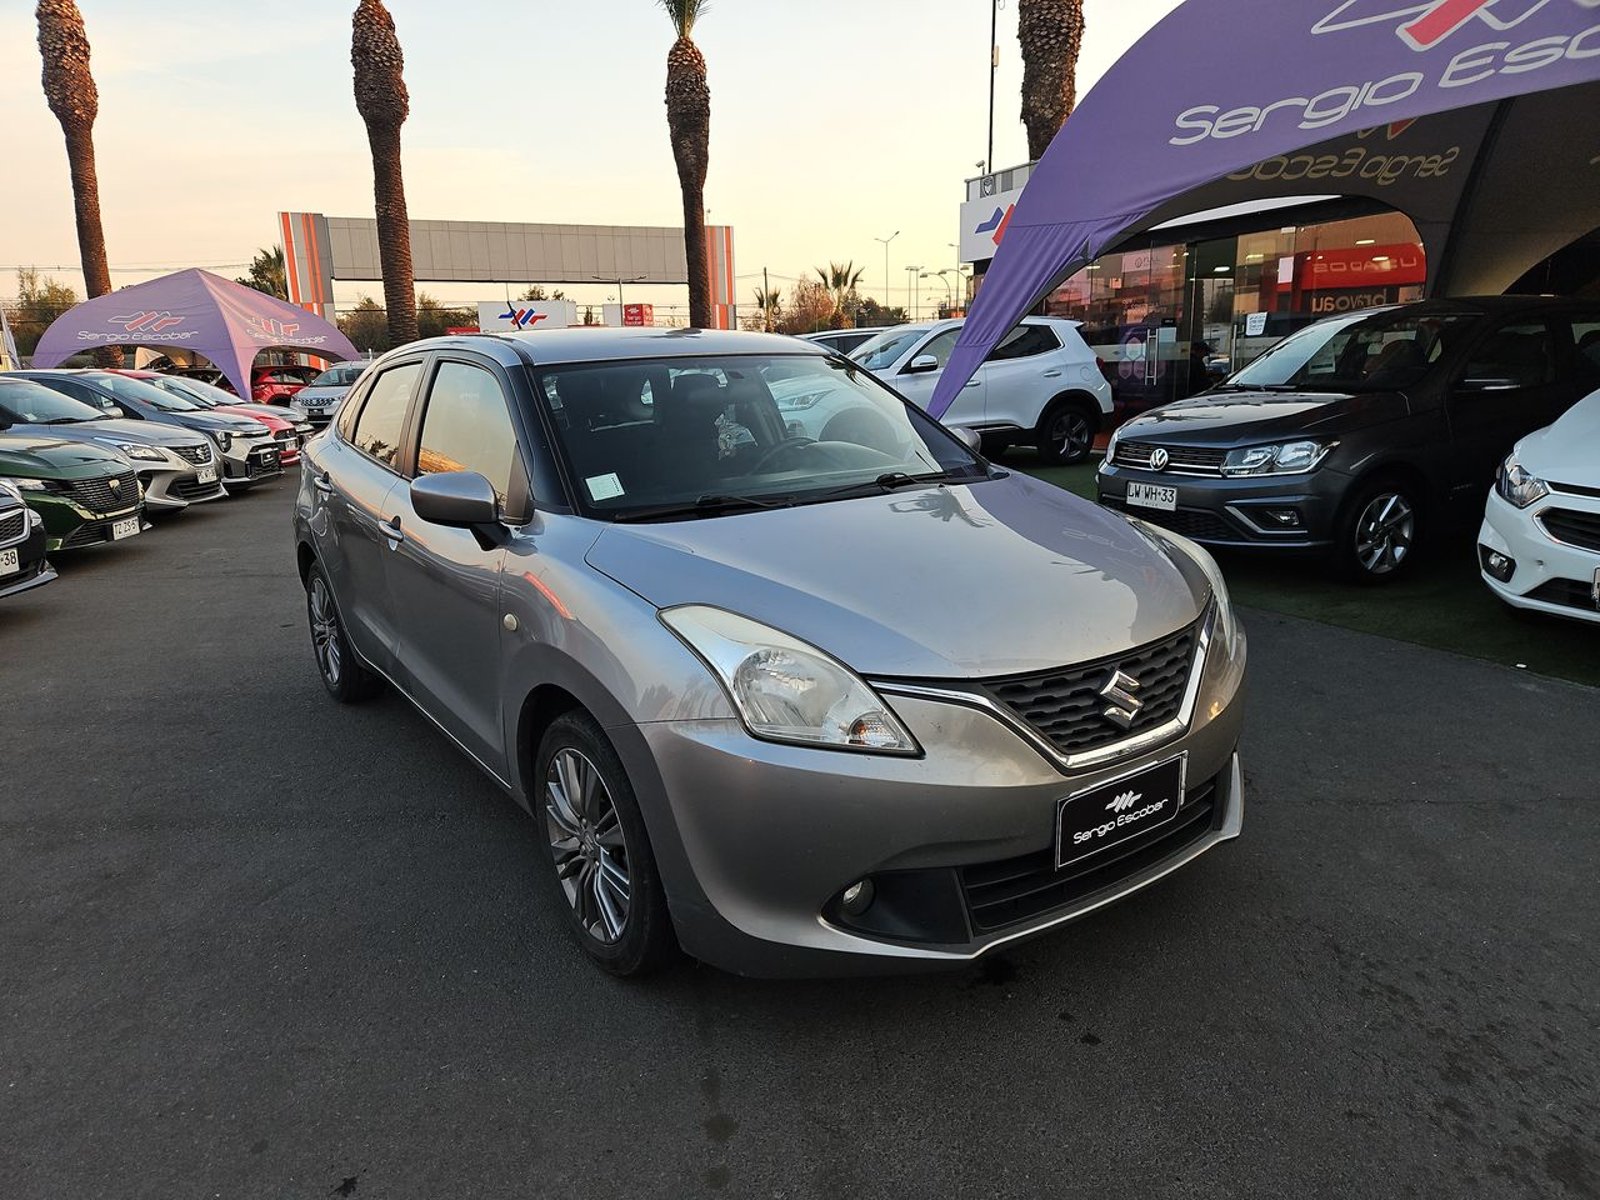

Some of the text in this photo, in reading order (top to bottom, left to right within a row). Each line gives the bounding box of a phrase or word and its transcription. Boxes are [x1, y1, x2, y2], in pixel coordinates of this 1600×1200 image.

[1169, 72, 1424, 146] Sergio
[77, 330, 199, 342] Sergio Escobar
[1073, 799, 1169, 845] Sergio Escobar
